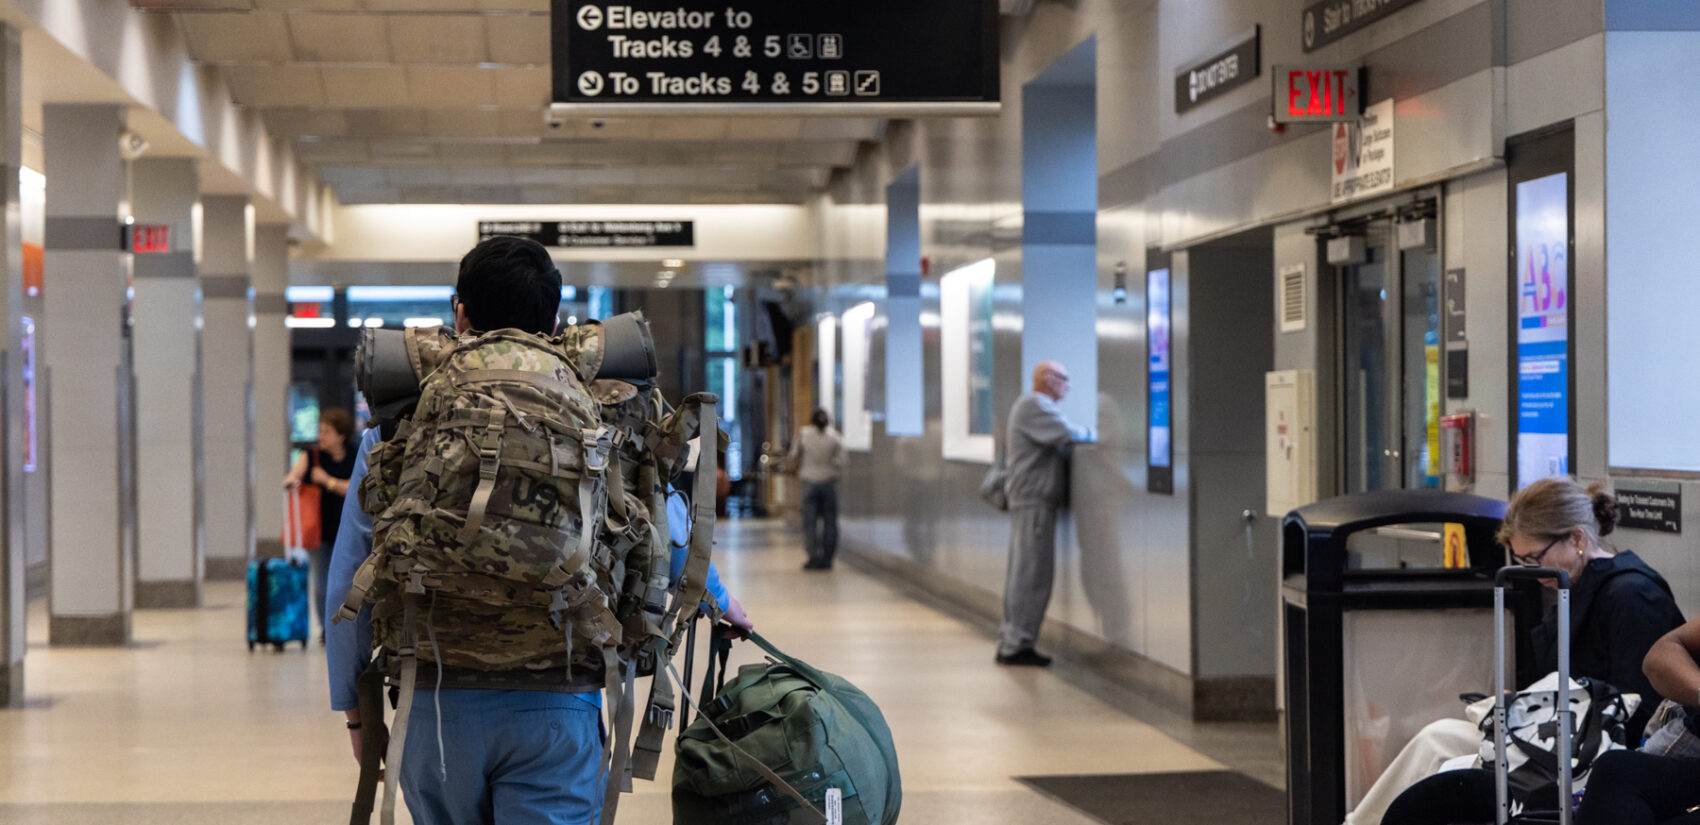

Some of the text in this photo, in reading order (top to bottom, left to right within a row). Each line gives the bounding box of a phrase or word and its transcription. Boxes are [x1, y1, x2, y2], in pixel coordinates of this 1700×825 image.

[606, 5, 752, 28] Elevator to
[607, 35, 781, 58] Tracks 4 & 5
[608, 70, 820, 94] To Tracks 4 & 5
[1289, 70, 1348, 116] EXIT
[133, 224, 169, 253] EXIT
[512, 476, 558, 513] US
